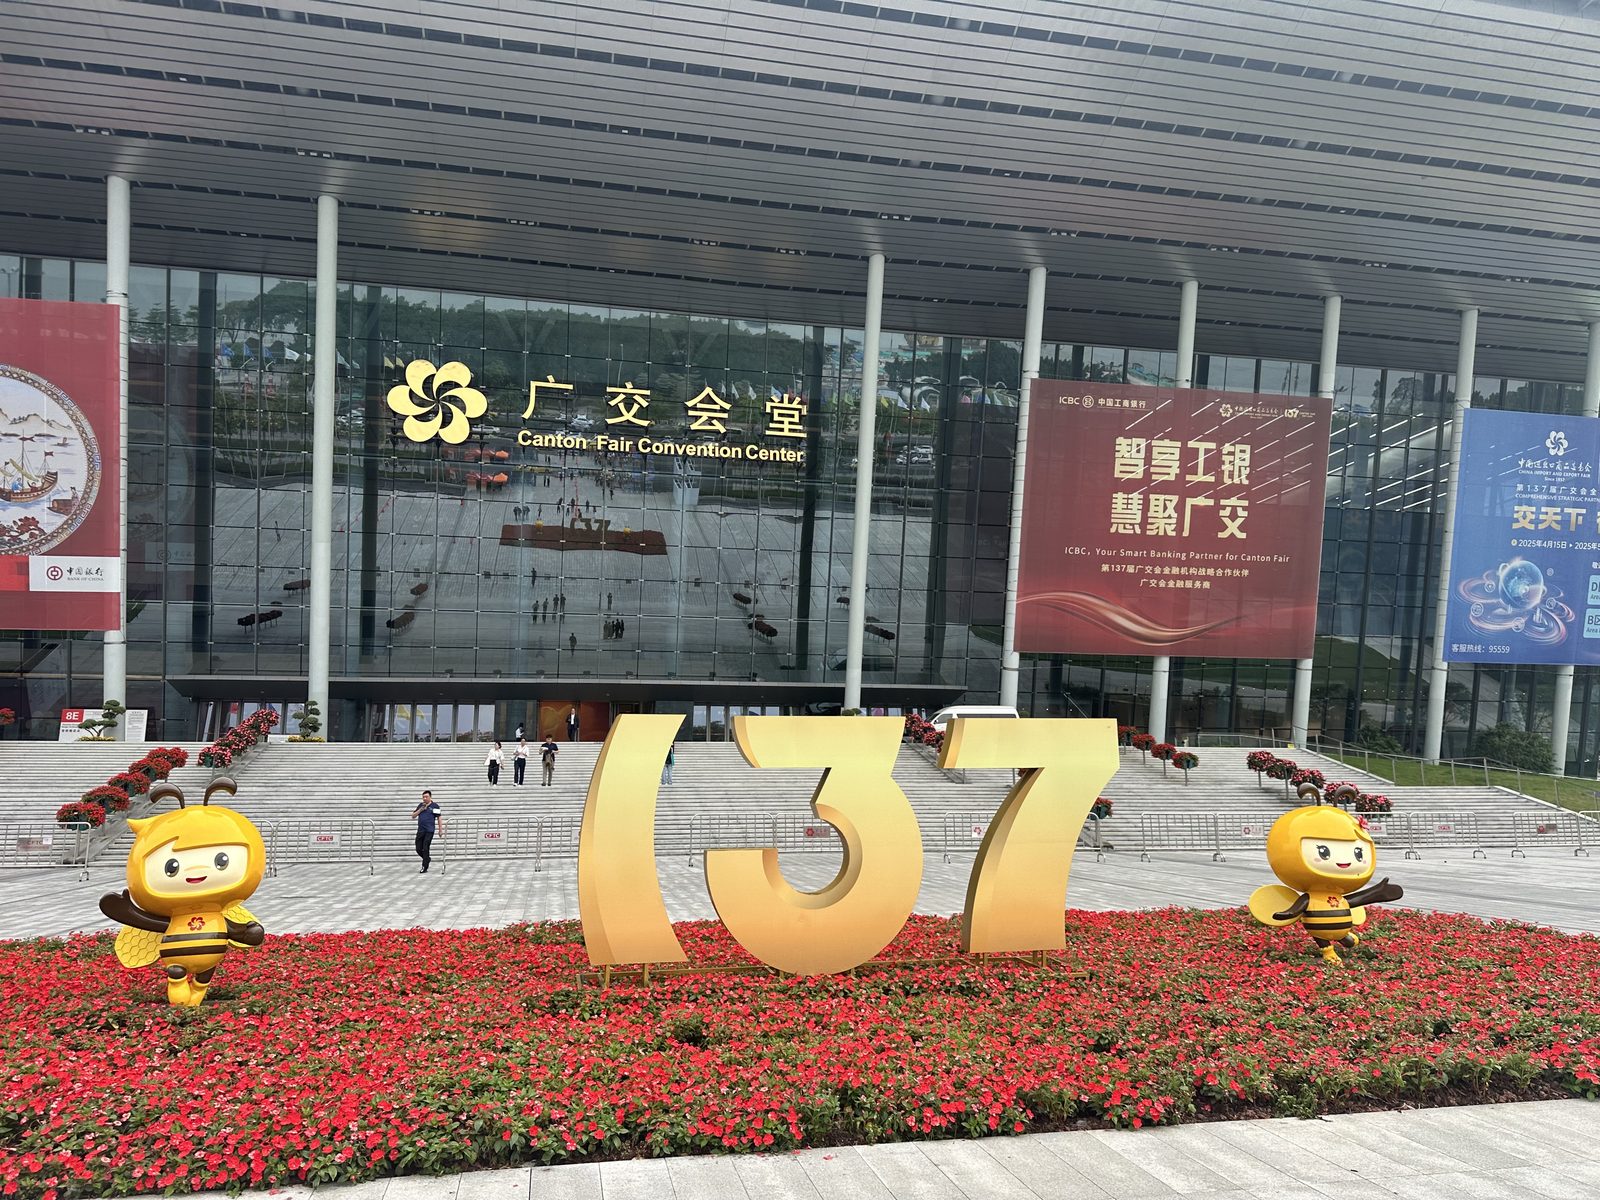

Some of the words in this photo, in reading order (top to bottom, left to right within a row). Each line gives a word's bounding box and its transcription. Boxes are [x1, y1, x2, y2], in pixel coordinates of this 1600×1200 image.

[522, 375, 807, 438] 广交会堂
[1059, 396, 1080, 405] ICBC
[1098, 398, 1146, 409] 中国工商银行
[517, 430, 587, 450] Canton
[596, 435, 633, 452] Fair
[637, 437, 742, 459] Convention
[745, 444, 805, 462] Center
[1114, 436, 1251, 484] 智享工银
[1515, 492, 1557, 501] COMPREHENSIVE
[1110, 492, 1249, 539] 慧聚广交
[1512, 505, 1586, 532] 交天下
[1518, 539, 1567, 549] 2025年4月15日
[1095, 547, 1117, 556] Your
[1119, 549, 1147, 557] Smart
[1150, 550, 1187, 560] Banking
[1189, 551, 1222, 560] Partner
[1225, 552, 1238, 561] for
[1240, 553, 1271, 562] Canton
[1273, 554, 1291, 563] Fair
[66, 566, 104, 577] 中国银行
[1101, 563, 1250, 577] 第137届广交会金融机构战略合作伙伴
[1139, 578, 1211, 589] 广交会金融服务商
[65, 711, 79, 720] 8E
[578, 713, 1120, 976] 137
